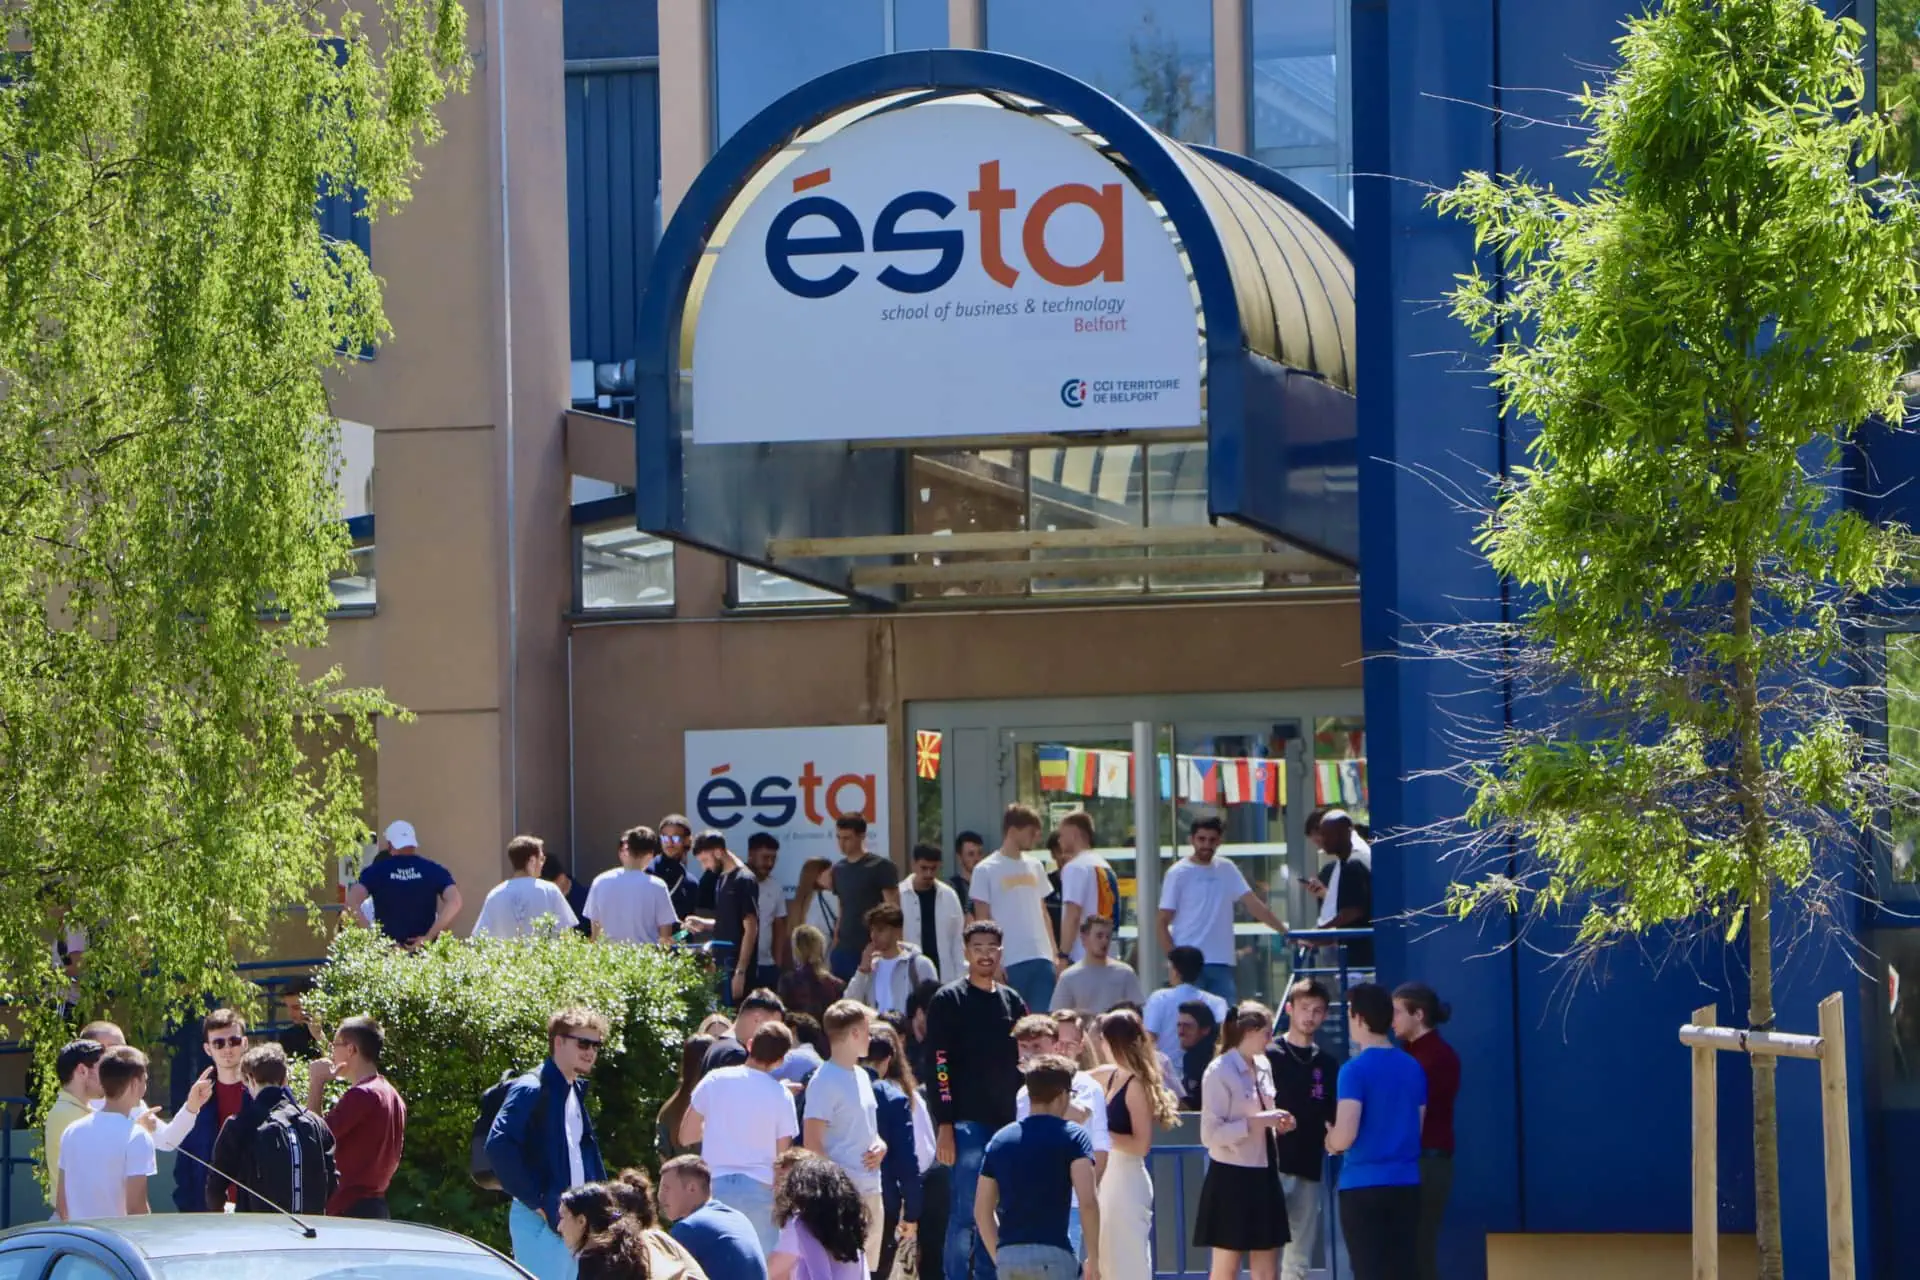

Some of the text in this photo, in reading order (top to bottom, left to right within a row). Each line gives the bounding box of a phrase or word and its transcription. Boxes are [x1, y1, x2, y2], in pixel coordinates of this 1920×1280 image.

[765, 159, 1124, 299] ésta
[881, 296, 1125, 322] school of business & technology
[1074, 317, 1128, 333] Belfort
[1093, 379, 1180, 392] CCI TERRITOIRE
[1093, 391, 1159, 404] DE BELFORT
[697, 760, 876, 829] ésta
